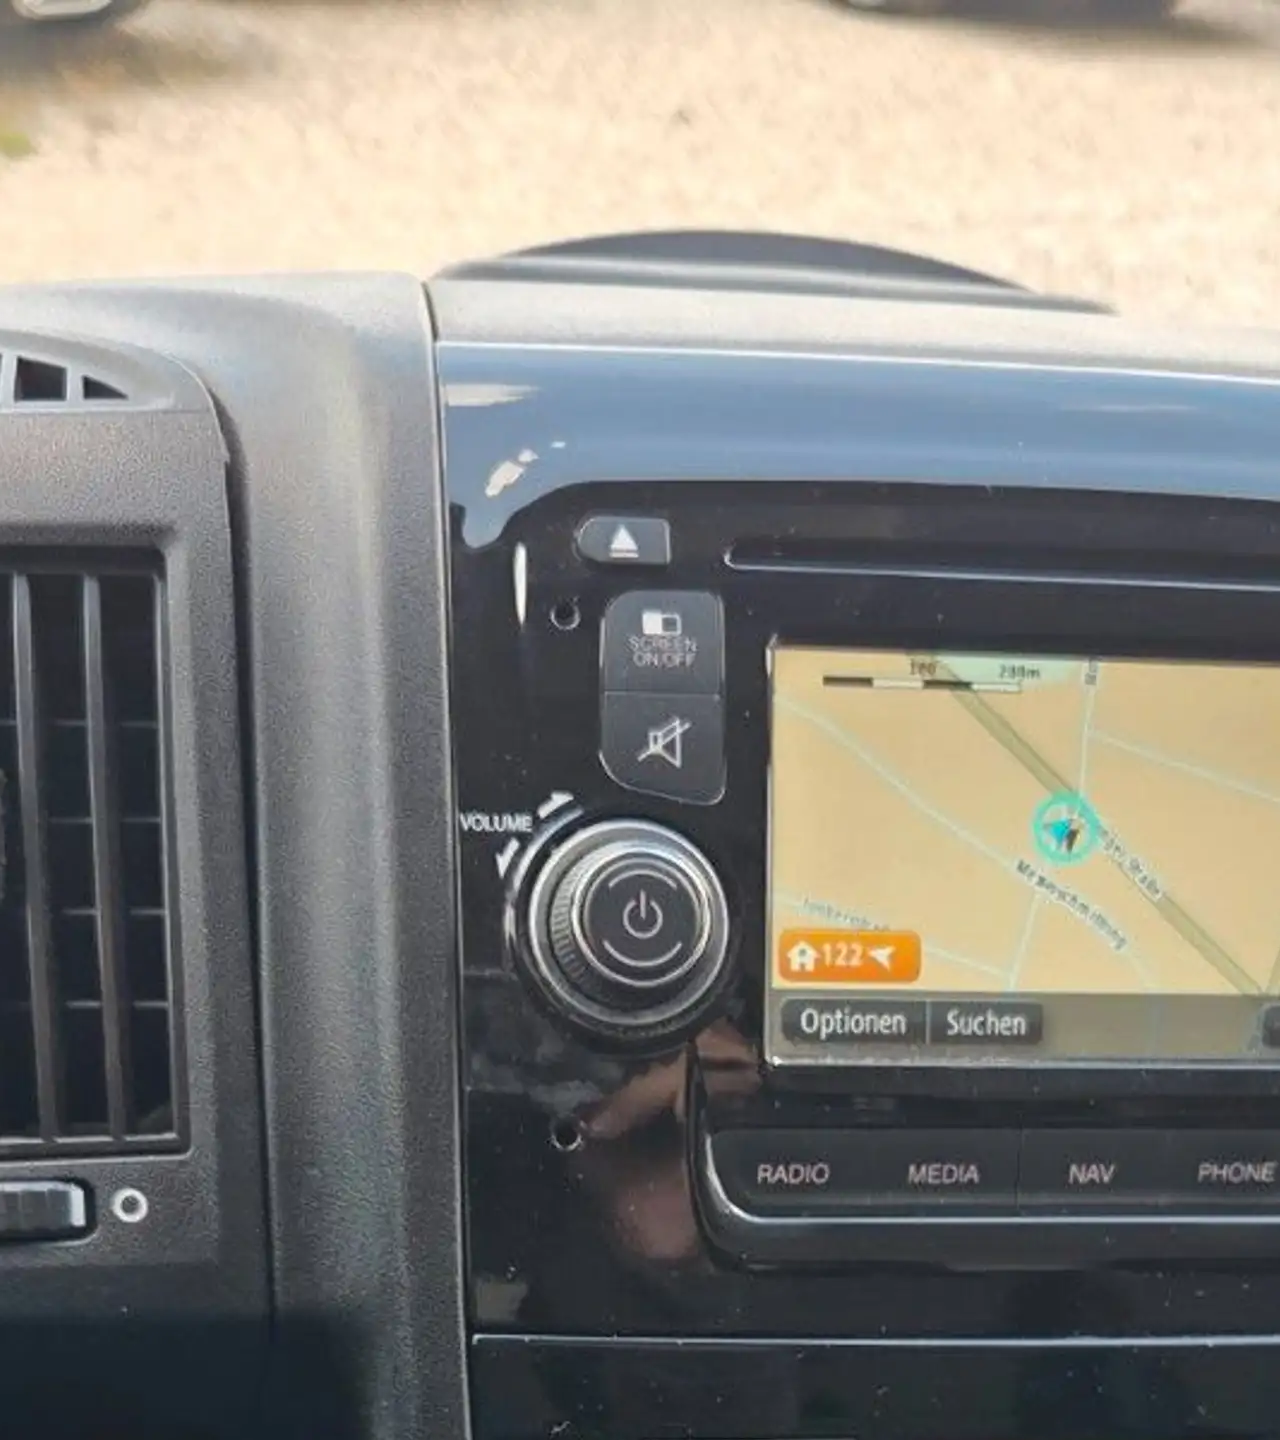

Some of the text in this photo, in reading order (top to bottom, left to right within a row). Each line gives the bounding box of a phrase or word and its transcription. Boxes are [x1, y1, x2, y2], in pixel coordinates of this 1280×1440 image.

[629, 636, 698, 653] SCREEN
[459, 812, 534, 832] VOLUME
[821, 942, 865, 968] 122
[799, 1005, 908, 1042] Optionen
[946, 1007, 1027, 1036] Suchen
[756, 1163, 830, 1185] RADIO
[907, 1163, 981, 1185] MEDIA
[1068, 1163, 1116, 1185] NAV
[1197, 1163, 1278, 1185] PHONE
